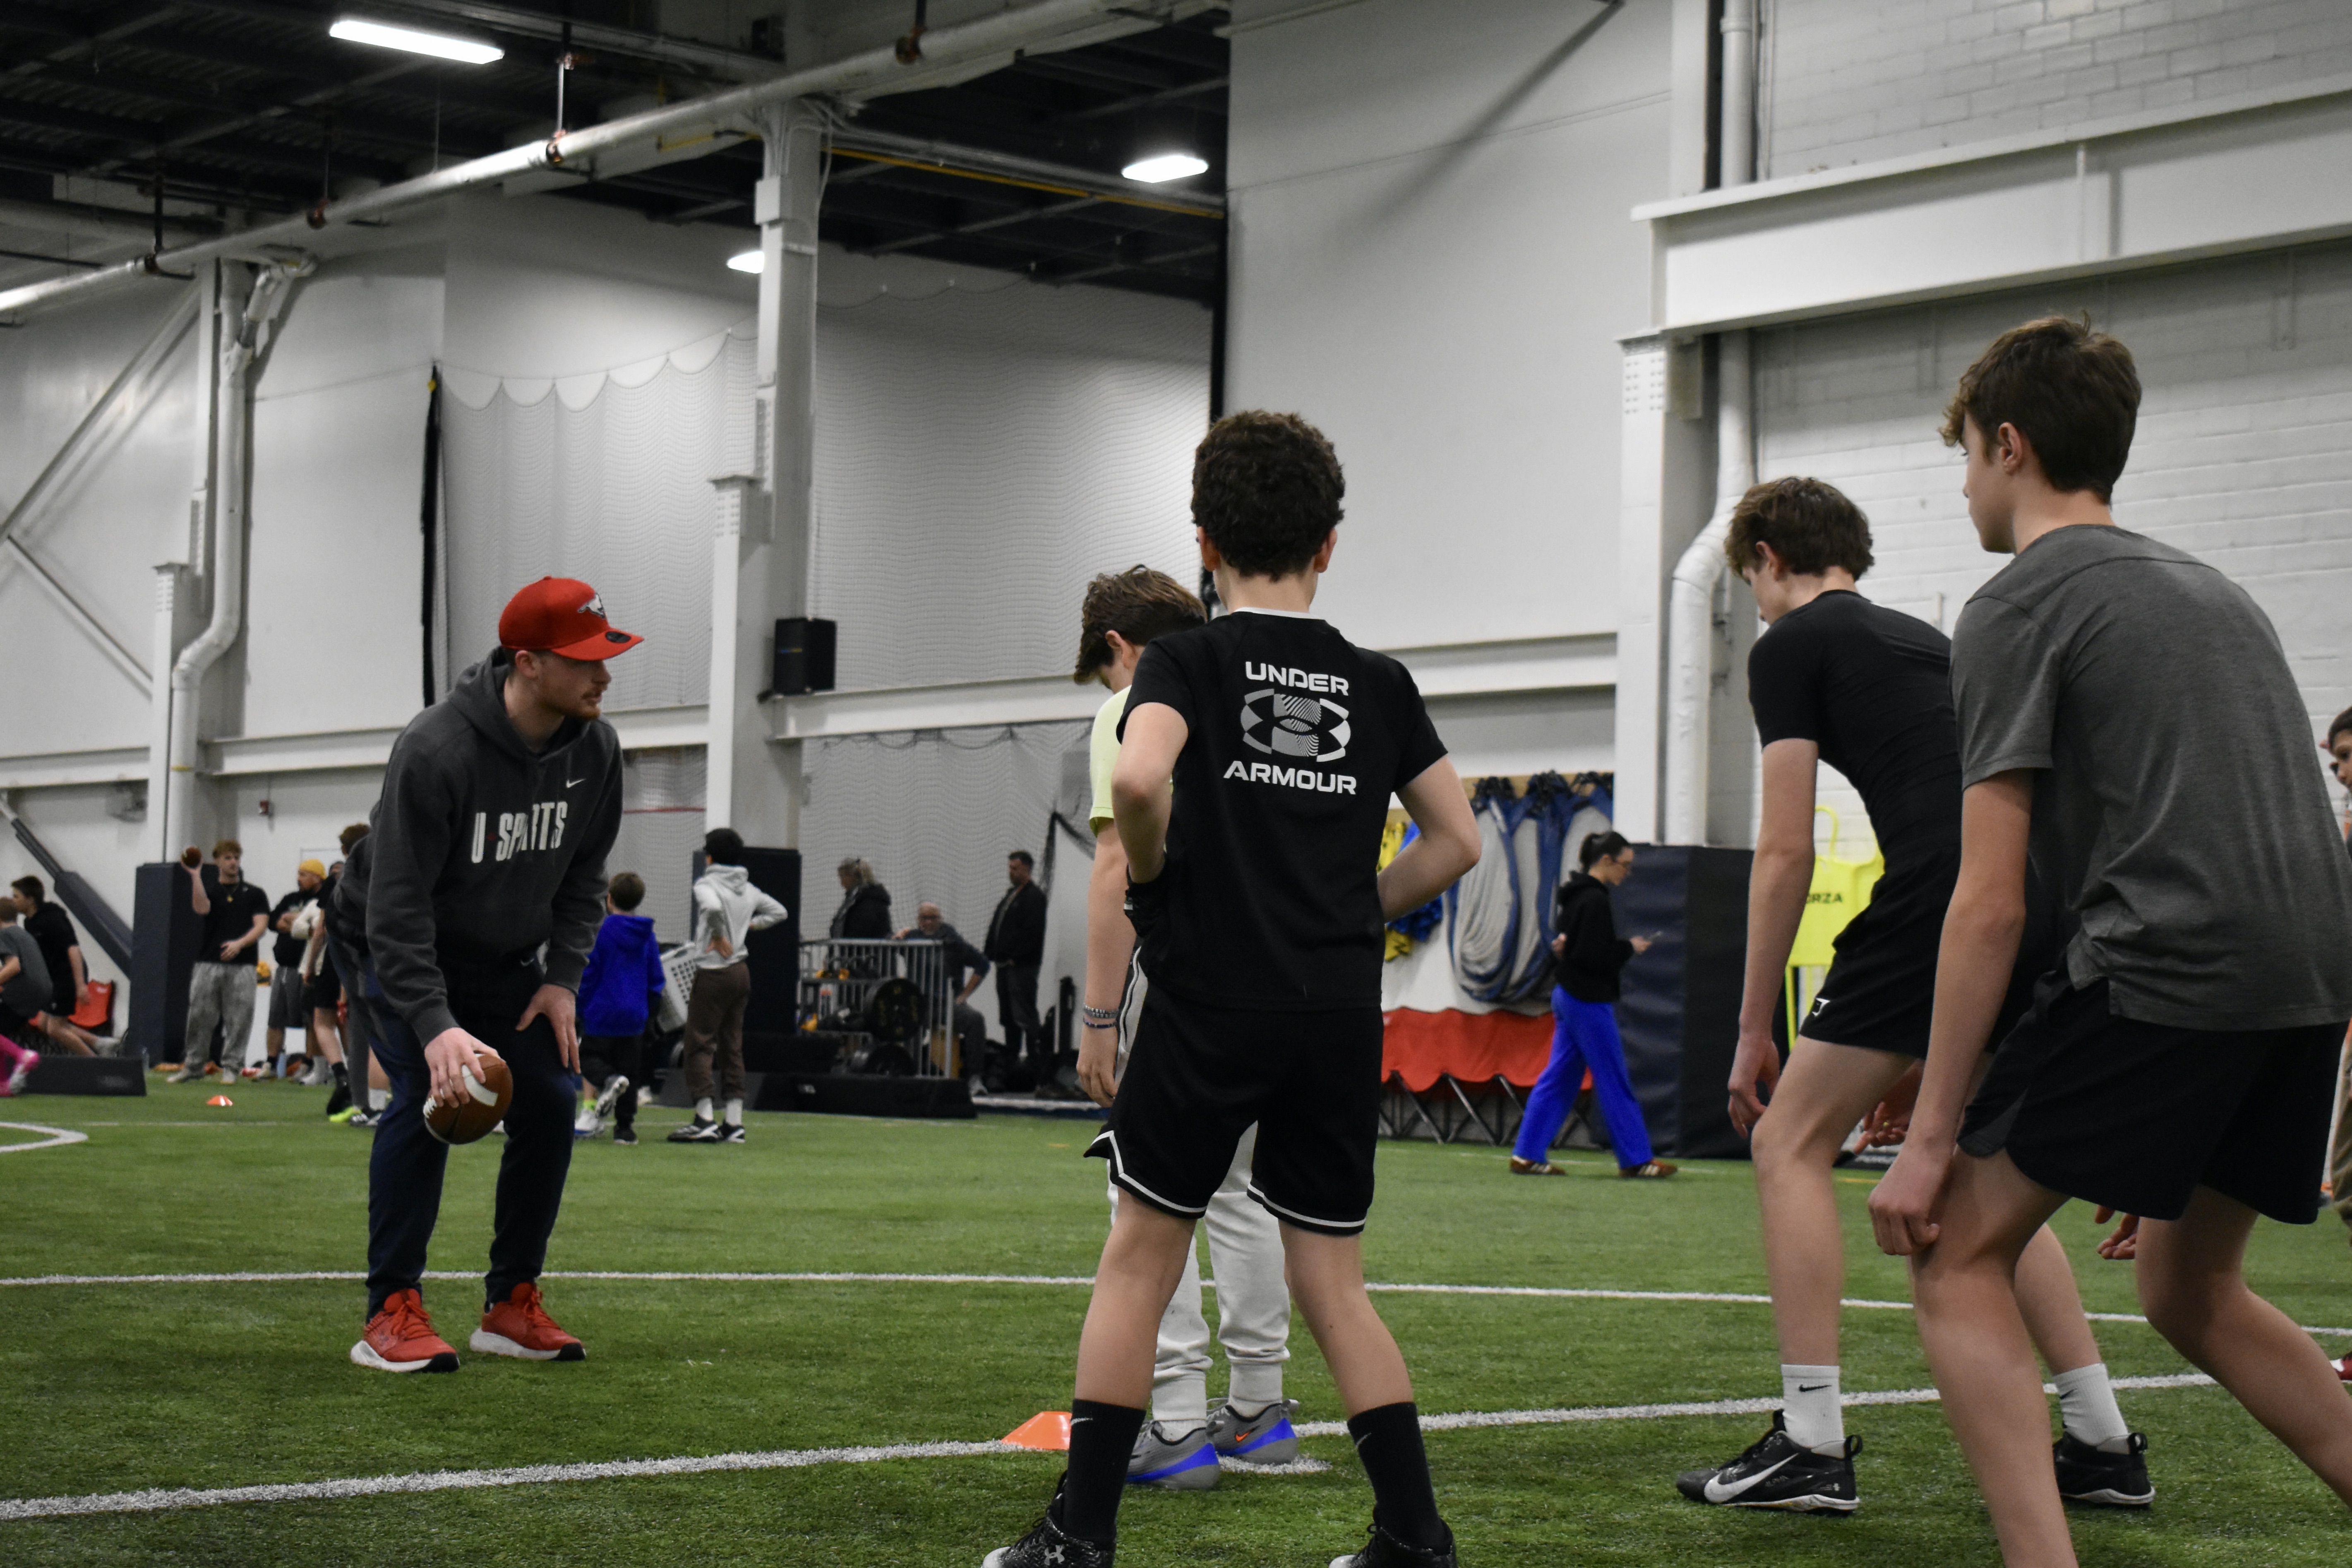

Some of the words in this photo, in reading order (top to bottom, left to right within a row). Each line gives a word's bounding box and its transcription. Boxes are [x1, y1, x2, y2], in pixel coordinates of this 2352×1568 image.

[1246, 661, 1349, 696] UNDER
[1223, 761, 1356, 795] ARMOUR
[471, 812, 486, 863] U
